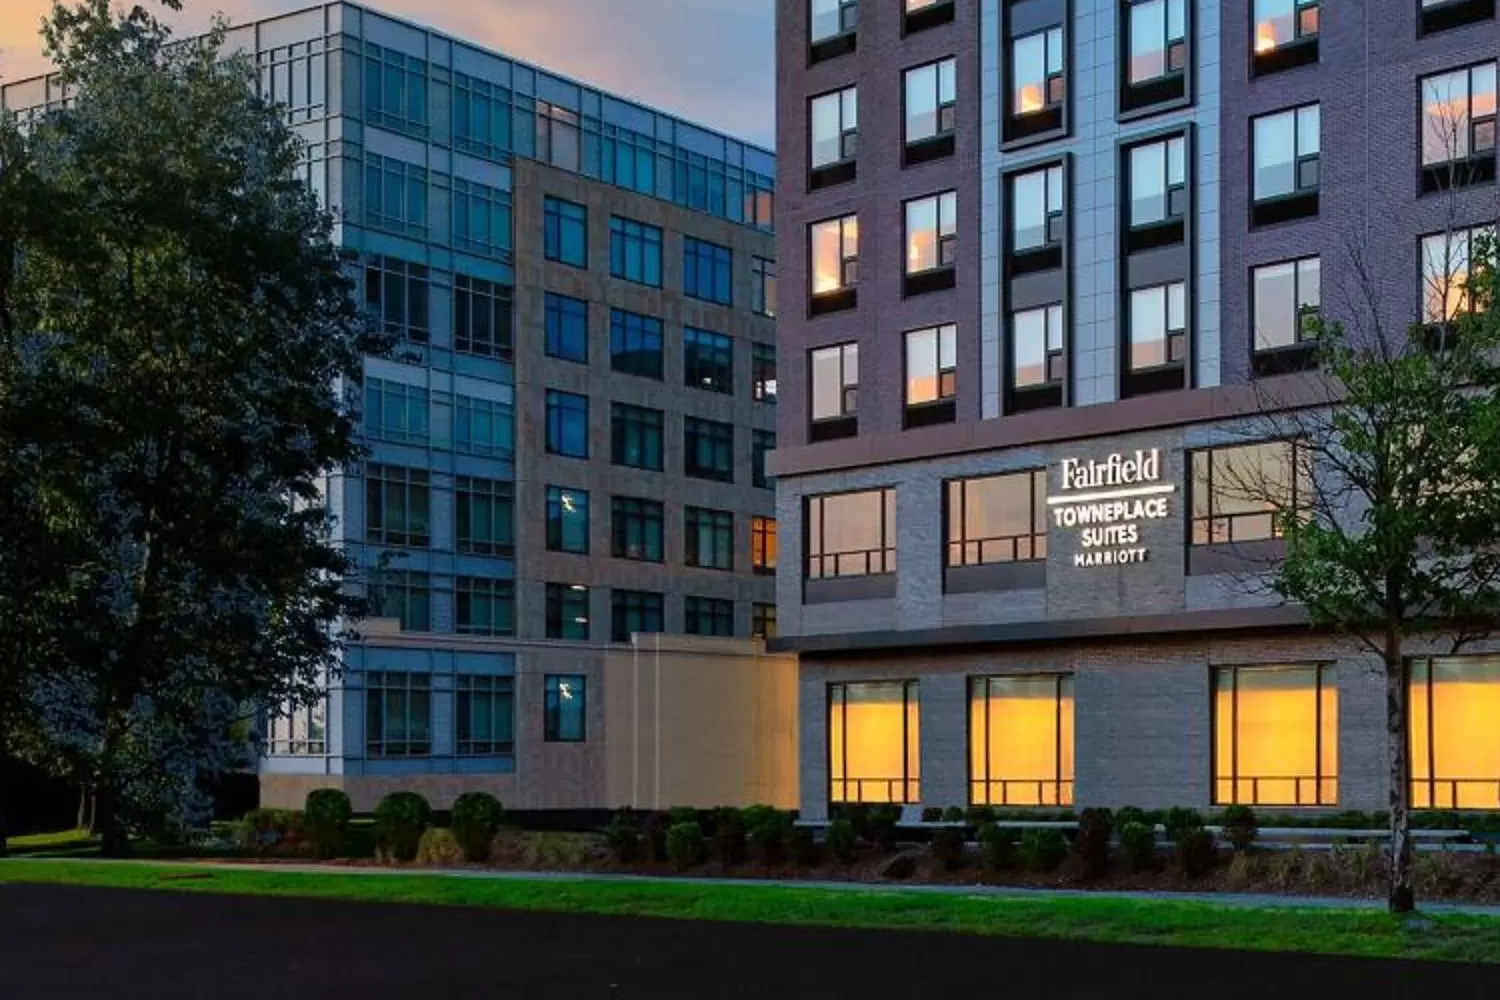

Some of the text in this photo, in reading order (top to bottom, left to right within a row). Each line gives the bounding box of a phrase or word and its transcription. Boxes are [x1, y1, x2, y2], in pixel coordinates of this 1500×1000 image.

[1061, 447, 1159, 489] Fairfield
[1053, 497, 1168, 527] TOWNEPLACE
[1081, 523, 1138, 547] SUITES
[1074, 547, 1147, 567] MARRIOTT
